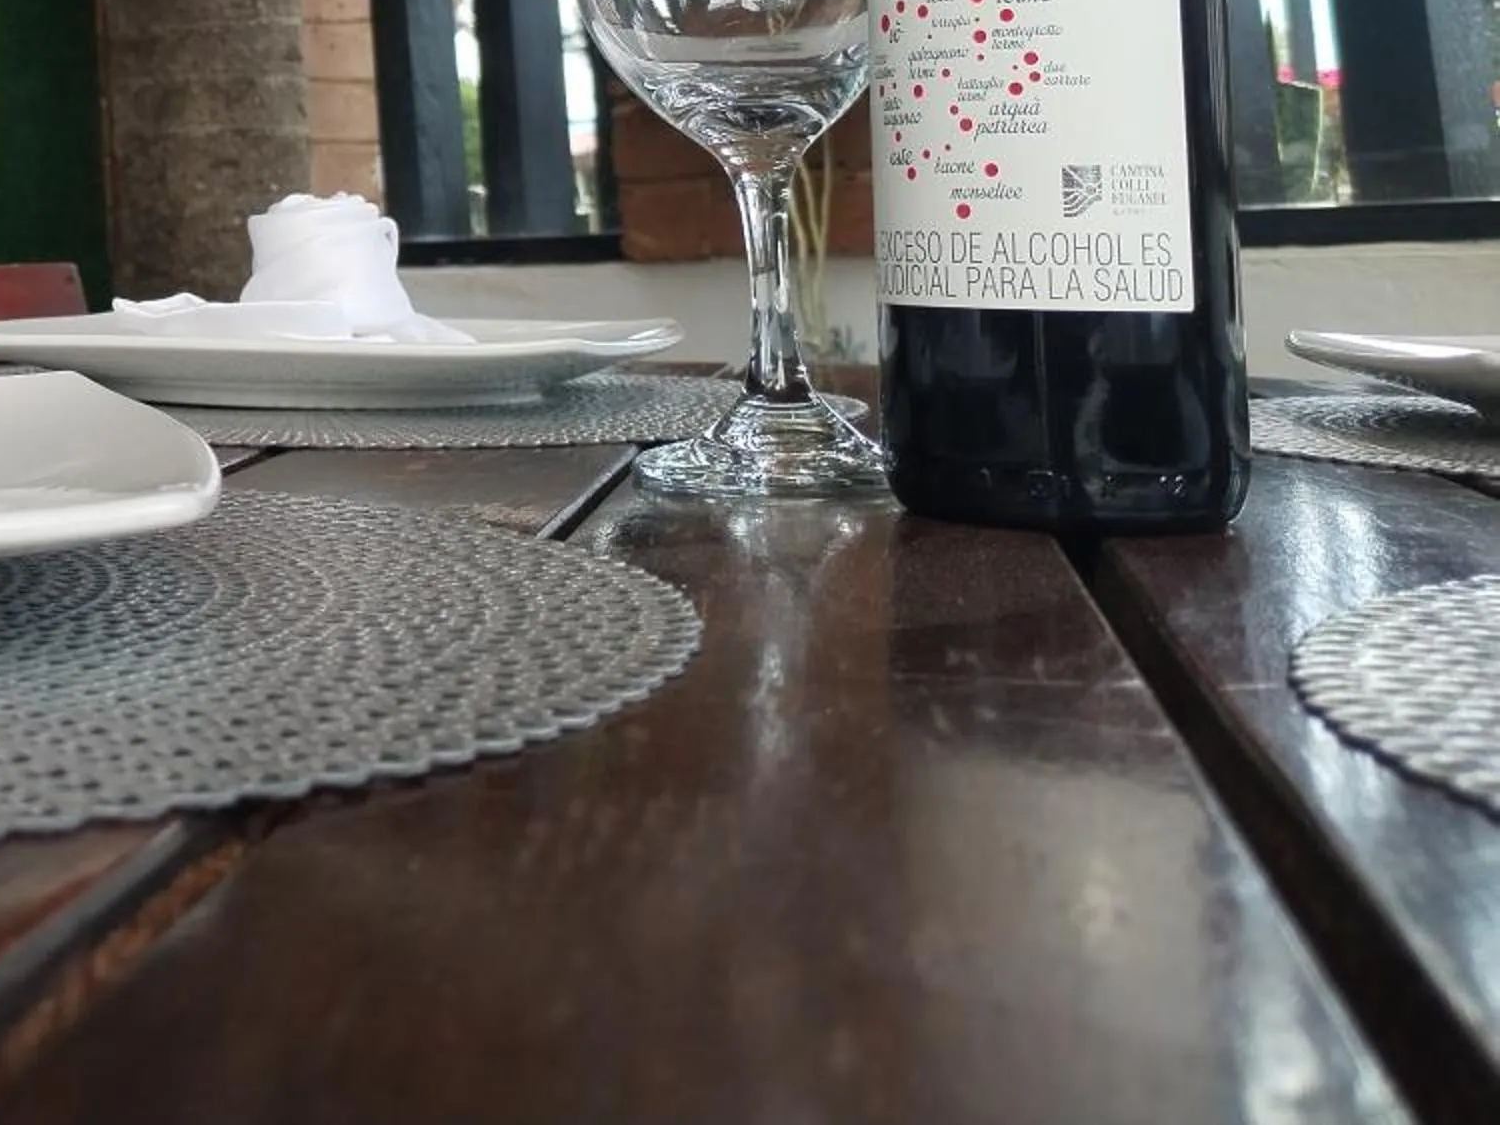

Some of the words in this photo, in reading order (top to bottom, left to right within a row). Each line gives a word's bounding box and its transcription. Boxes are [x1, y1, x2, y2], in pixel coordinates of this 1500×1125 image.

[949, 182, 1023, 201] monselice
[951, 231, 983, 264] DE
[991, 232, 1133, 266] ALCOHOL
[1140, 233, 1173, 266] ES
[966, 266, 1038, 300] PARA
[1047, 267, 1085, 301] LA
[1093, 267, 1184, 303] SALUD
